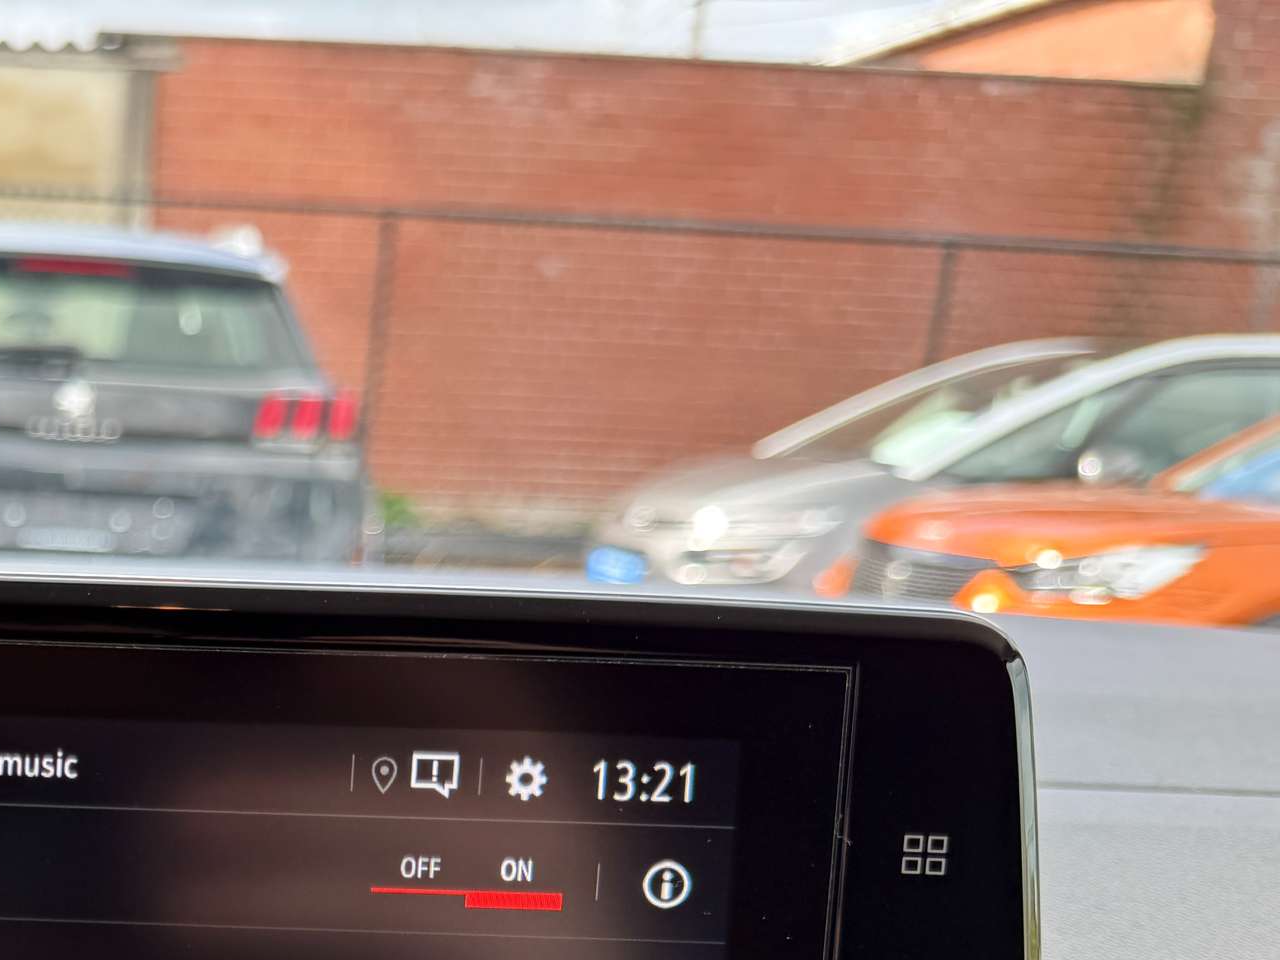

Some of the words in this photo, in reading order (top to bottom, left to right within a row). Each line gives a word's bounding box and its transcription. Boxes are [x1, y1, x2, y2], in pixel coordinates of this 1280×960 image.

[592, 758, 696, 804] 13:21
[399, 855, 442, 880] OFF
[499, 857, 534, 883] ON
